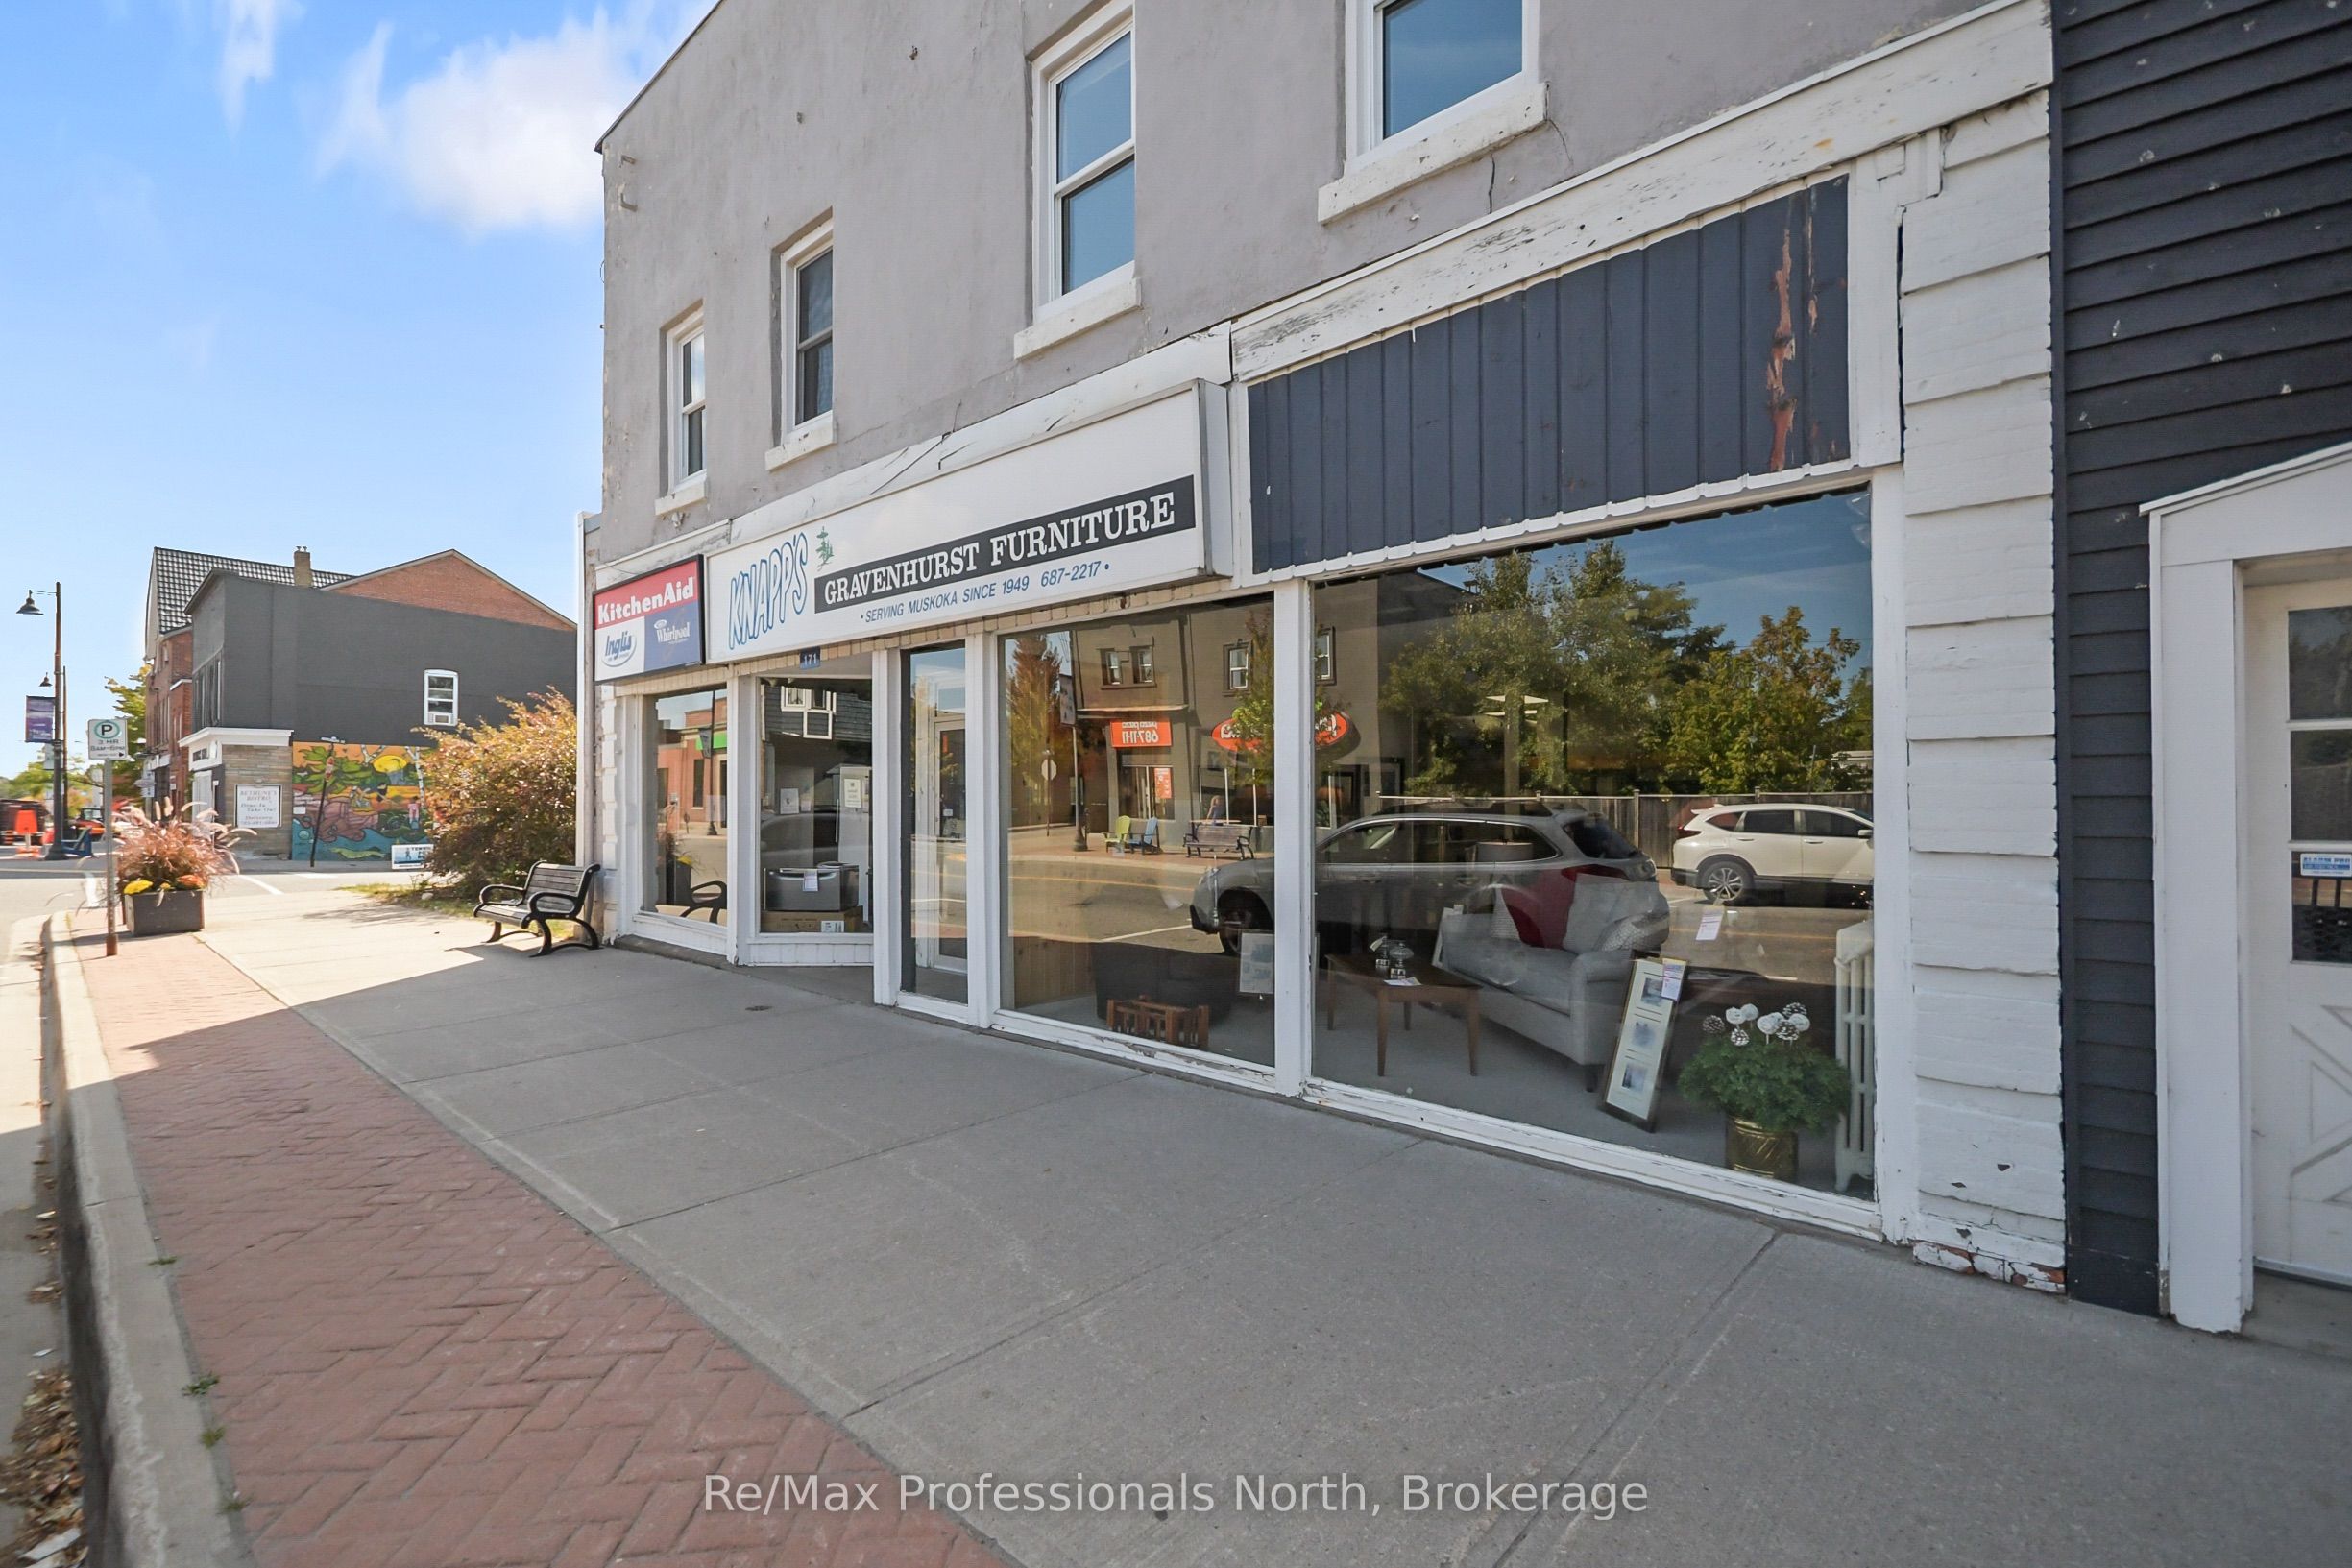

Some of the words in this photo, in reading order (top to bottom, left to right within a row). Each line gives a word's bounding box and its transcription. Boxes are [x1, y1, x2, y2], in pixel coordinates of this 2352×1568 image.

[824, 542, 980, 605] GRAVENHURST
[989, 491, 1175, 567] FURNITURE
[597, 576, 694, 625] KitchenAid
[728, 531, 809, 651] KNAPP'S
[865, 602, 904, 623] SERVING
[908, 591, 958, 615] MUSKOKA
[962, 582, 997, 603] SINCE
[1002, 575, 1030, 595] 1949
[1040, 560, 1102, 588] 687-2217
[604, 630, 632, 661] Inglis
[656, 621, 691, 643] Whirlpool
[804, 653, 817, 665] 171
[101, 724, 113, 736] P
